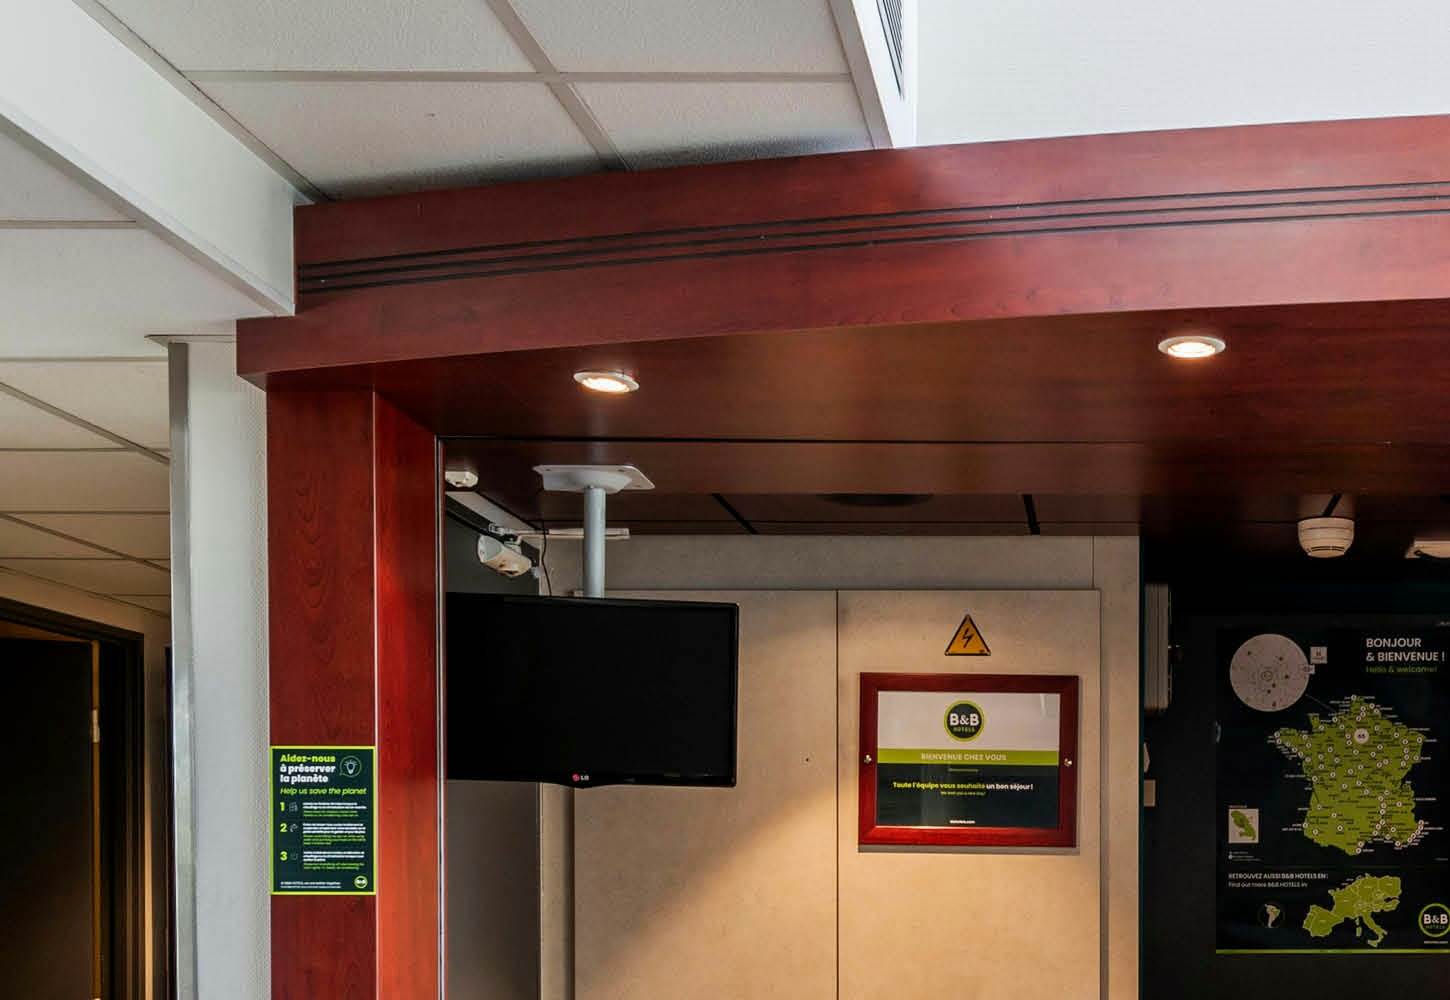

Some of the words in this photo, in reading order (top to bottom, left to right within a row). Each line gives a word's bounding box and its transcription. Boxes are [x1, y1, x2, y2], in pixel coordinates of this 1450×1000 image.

[1366, 637, 1422, 648] BONJOUR
[1366, 651, 1376, 662] &
[1377, 651, 1439, 662] BIENVENUE
[950, 713, 979, 726] B&B
[280, 754, 336, 763] Aidez-nous
[921, 753, 962, 761] BIENVENUE
[963, 753, 984, 761] CHEZ
[985, 753, 1007, 761] VOUS
[280, 763, 287, 773] à
[288, 763, 336, 775] préserver
[280, 774, 290, 783] la
[291, 773, 329, 785] planète
[892, 781, 911, 789] Toute
[280, 787, 297, 797] Help
[328, 787, 341, 795] the
[341, 787, 367, 797] planet
[280, 802, 285, 811] 1
[280, 822, 288, 833] 2
[280, 851, 288, 861] 3
[1424, 914, 1449, 925] B&B
